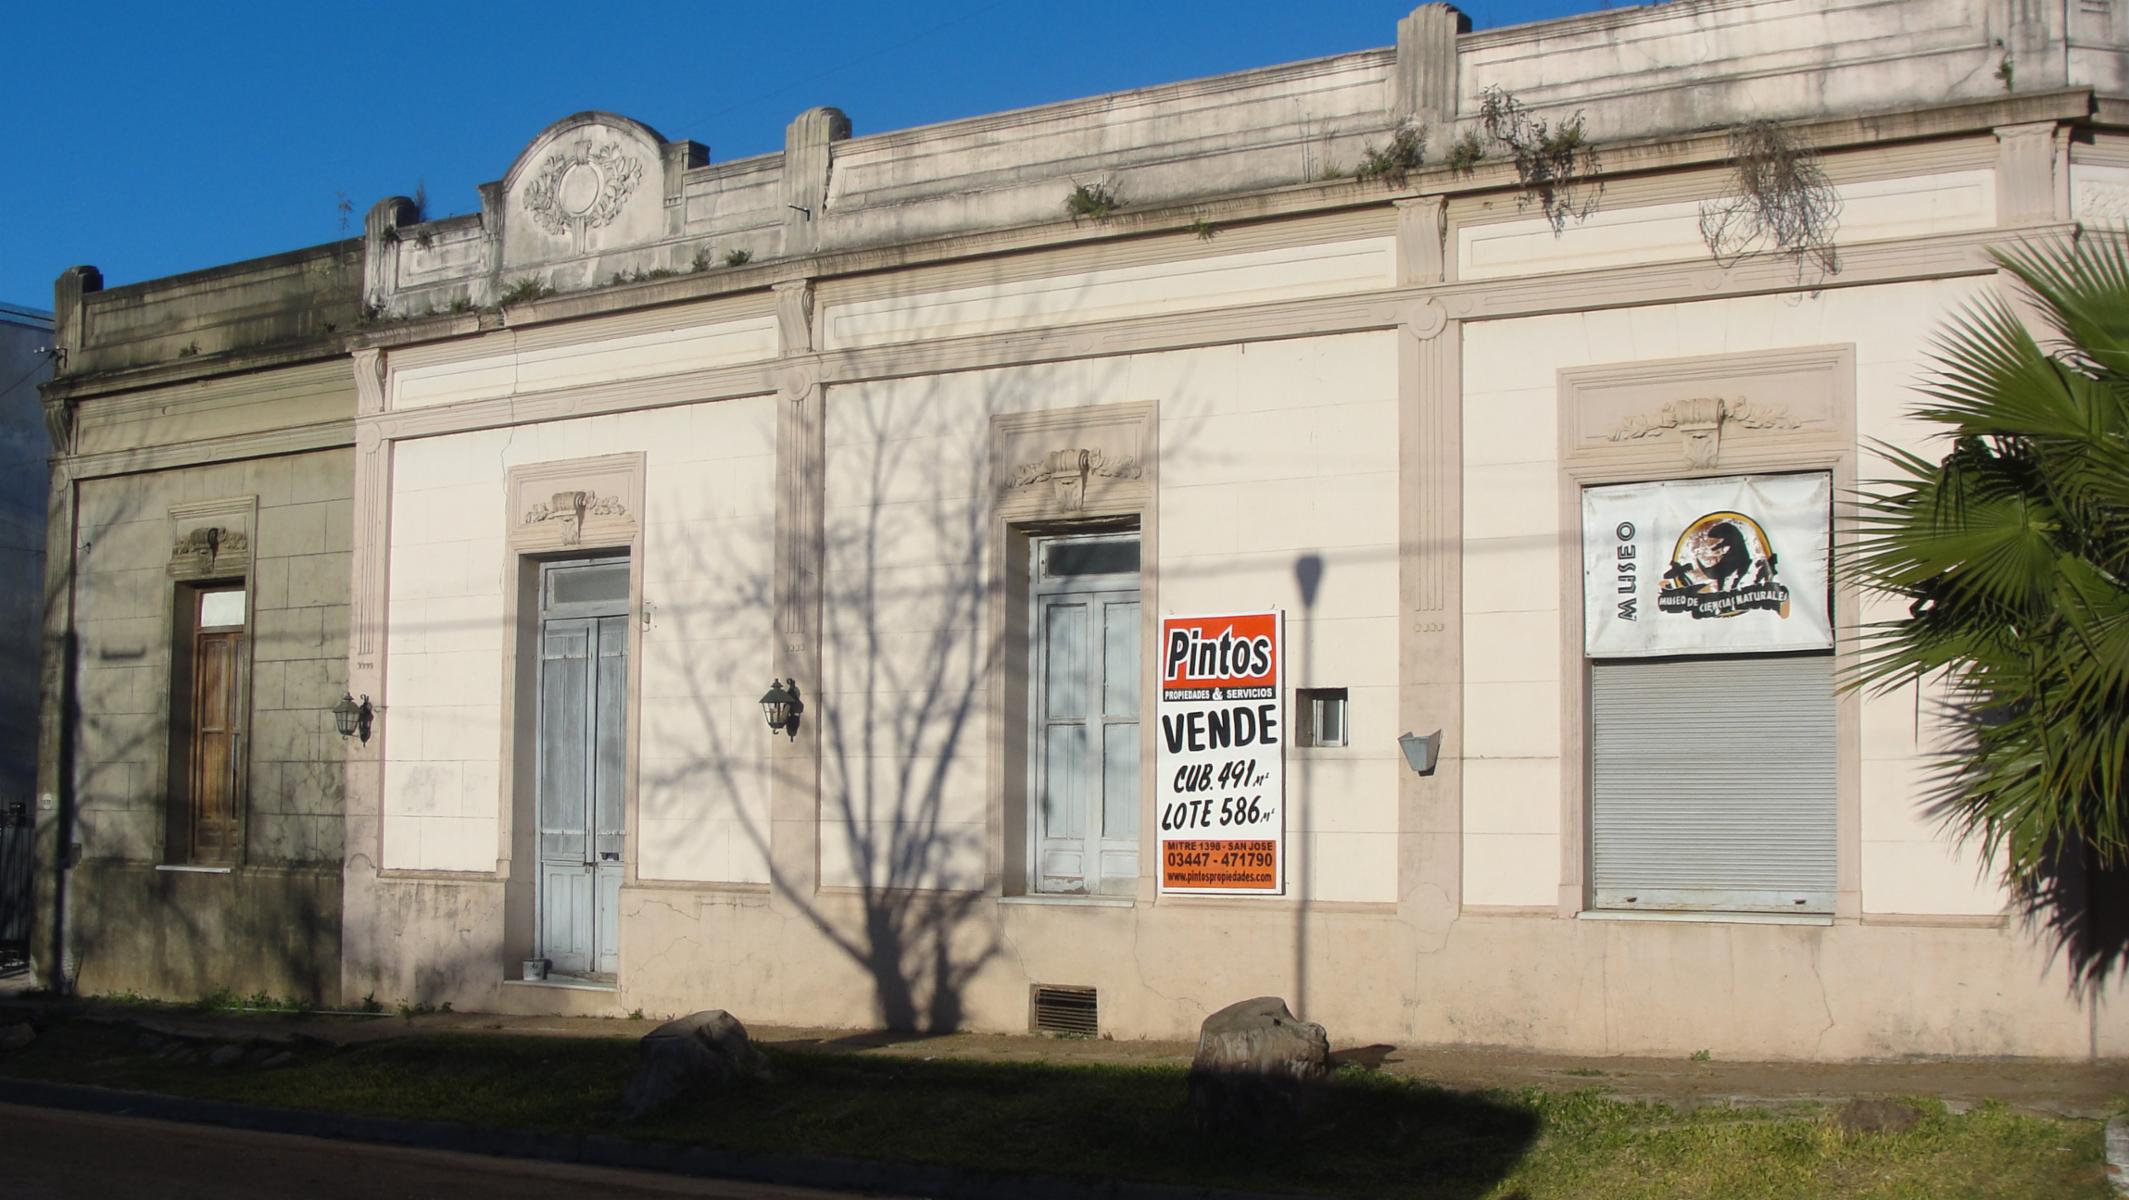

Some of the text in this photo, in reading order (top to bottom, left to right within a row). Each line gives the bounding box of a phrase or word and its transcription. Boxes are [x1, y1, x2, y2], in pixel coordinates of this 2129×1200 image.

[1616, 521, 1638, 622] MUSEO
[1659, 595, 1686, 605] MUSEO
[1687, 597, 1699, 607] DE
[1165, 624, 1272, 680] Pintos
[1165, 687, 1273, 700] PROPIEDADES & SERVICIOS
[1162, 704, 1278, 754] VENDE
[1173, 763, 1213, 793] CUB.
[1161, 799, 1214, 831] LOTE
[1219, 795, 1261, 826] 586
[1167, 842, 1197, 851] MITRE
[1228, 842, 1247, 851] SAN
[1248, 842, 1273, 851] JOSE
[1168, 853, 1210, 867] 03447
[1221, 853, 1273, 867] 471790
[1167, 870, 1272, 884] www.pintospropiedades.com
